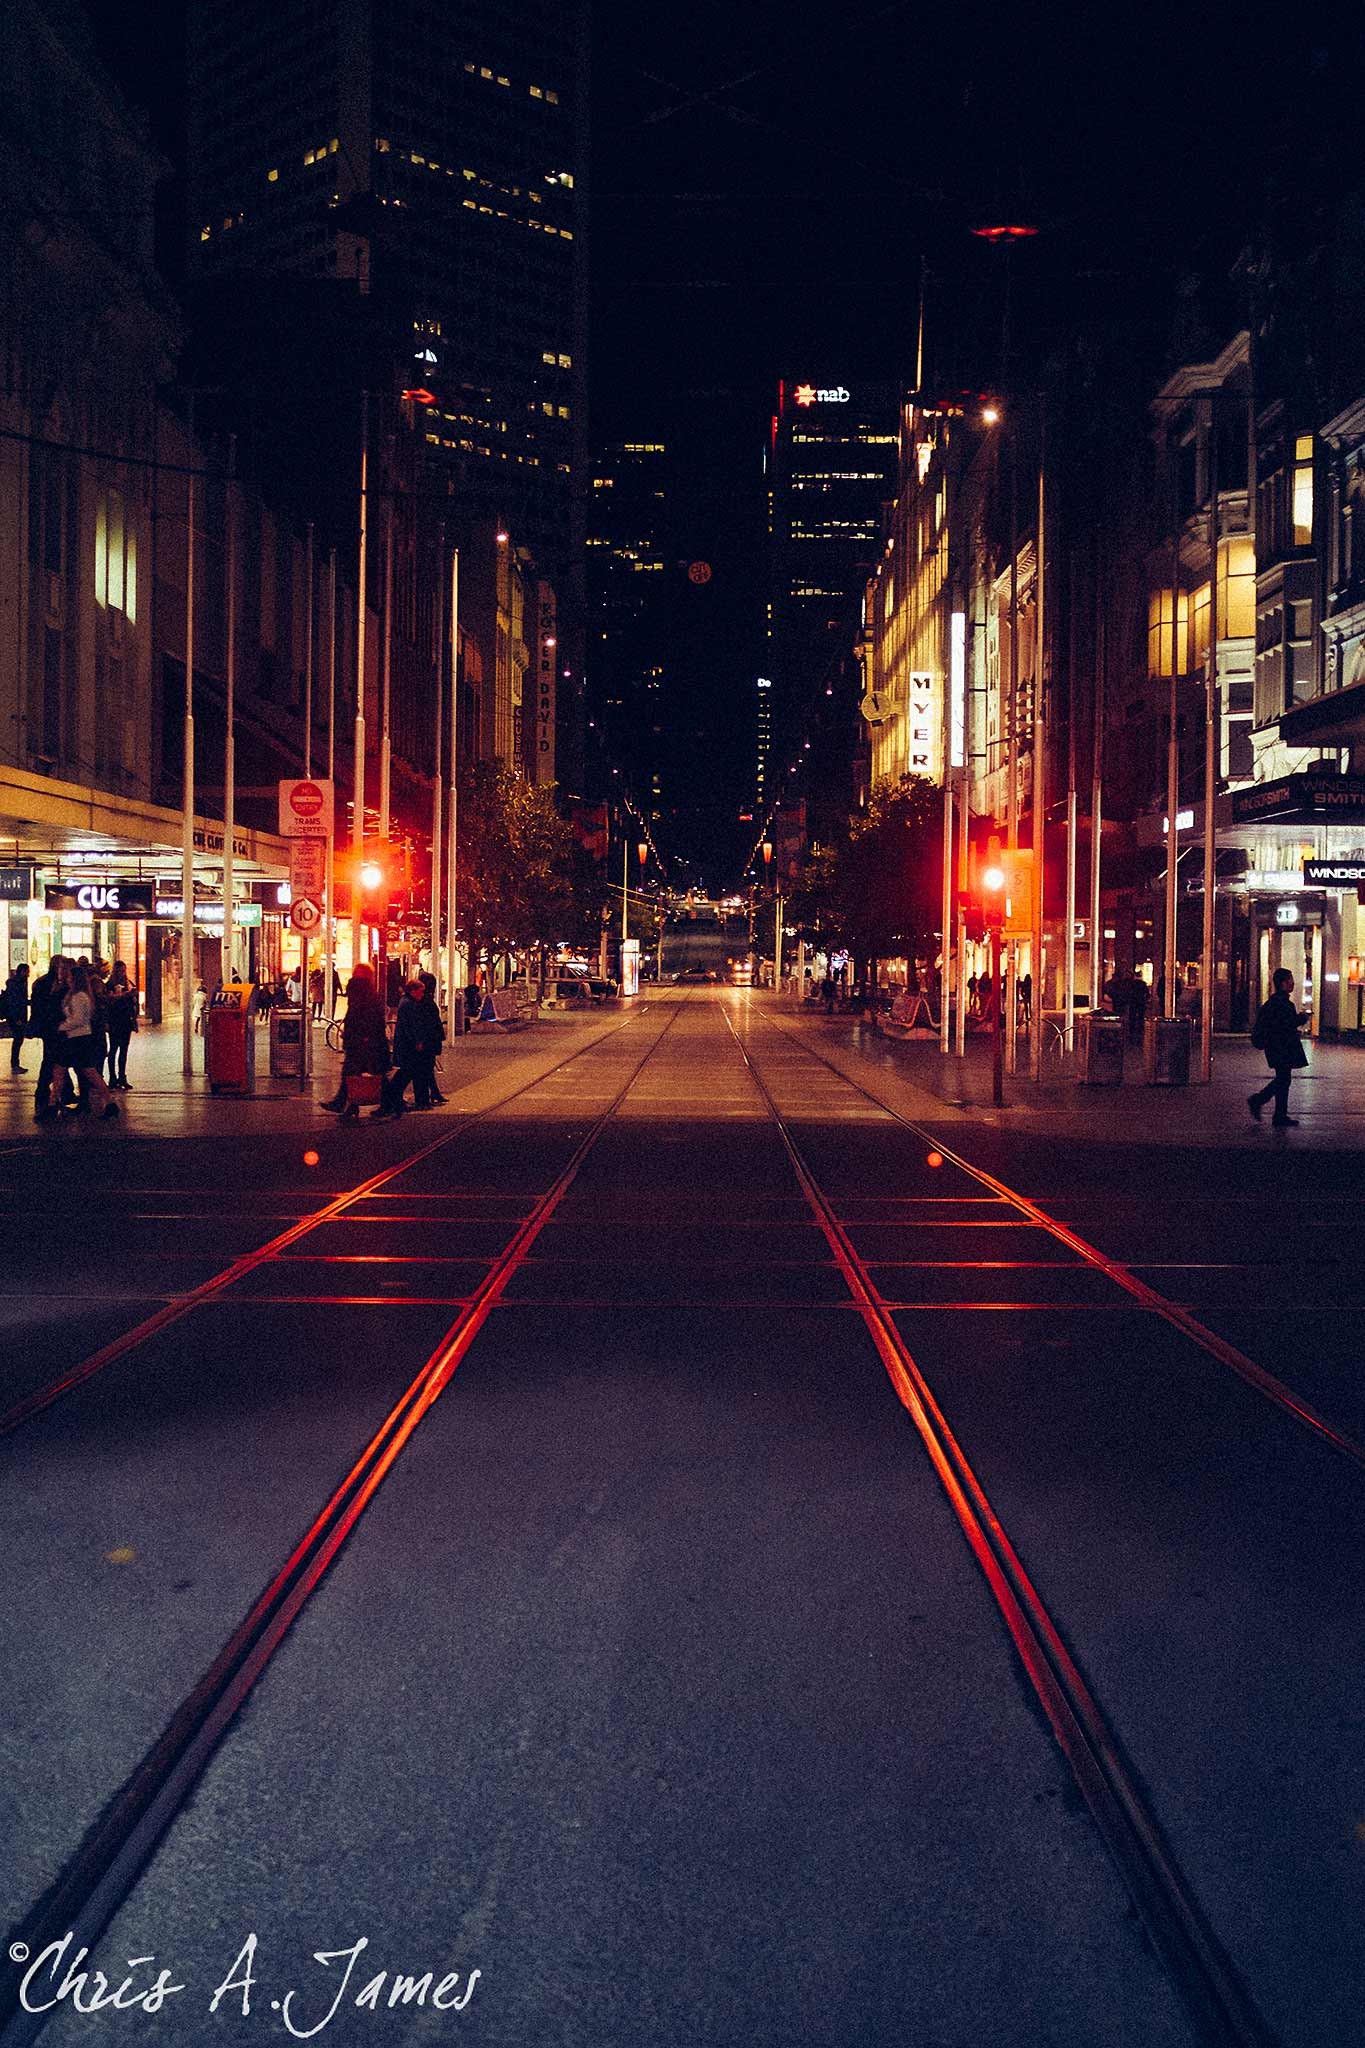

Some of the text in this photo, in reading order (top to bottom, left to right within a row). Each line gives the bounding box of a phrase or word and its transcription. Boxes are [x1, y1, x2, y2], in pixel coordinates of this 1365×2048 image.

[816, 386, 851, 402] nab
[540, 682, 550, 752] DAVID
[913, 677, 930, 766] MYER
[294, 817, 321, 825] TRAMS
[78, 885, 119, 909] CUE
[298, 907, 313, 922] 10
